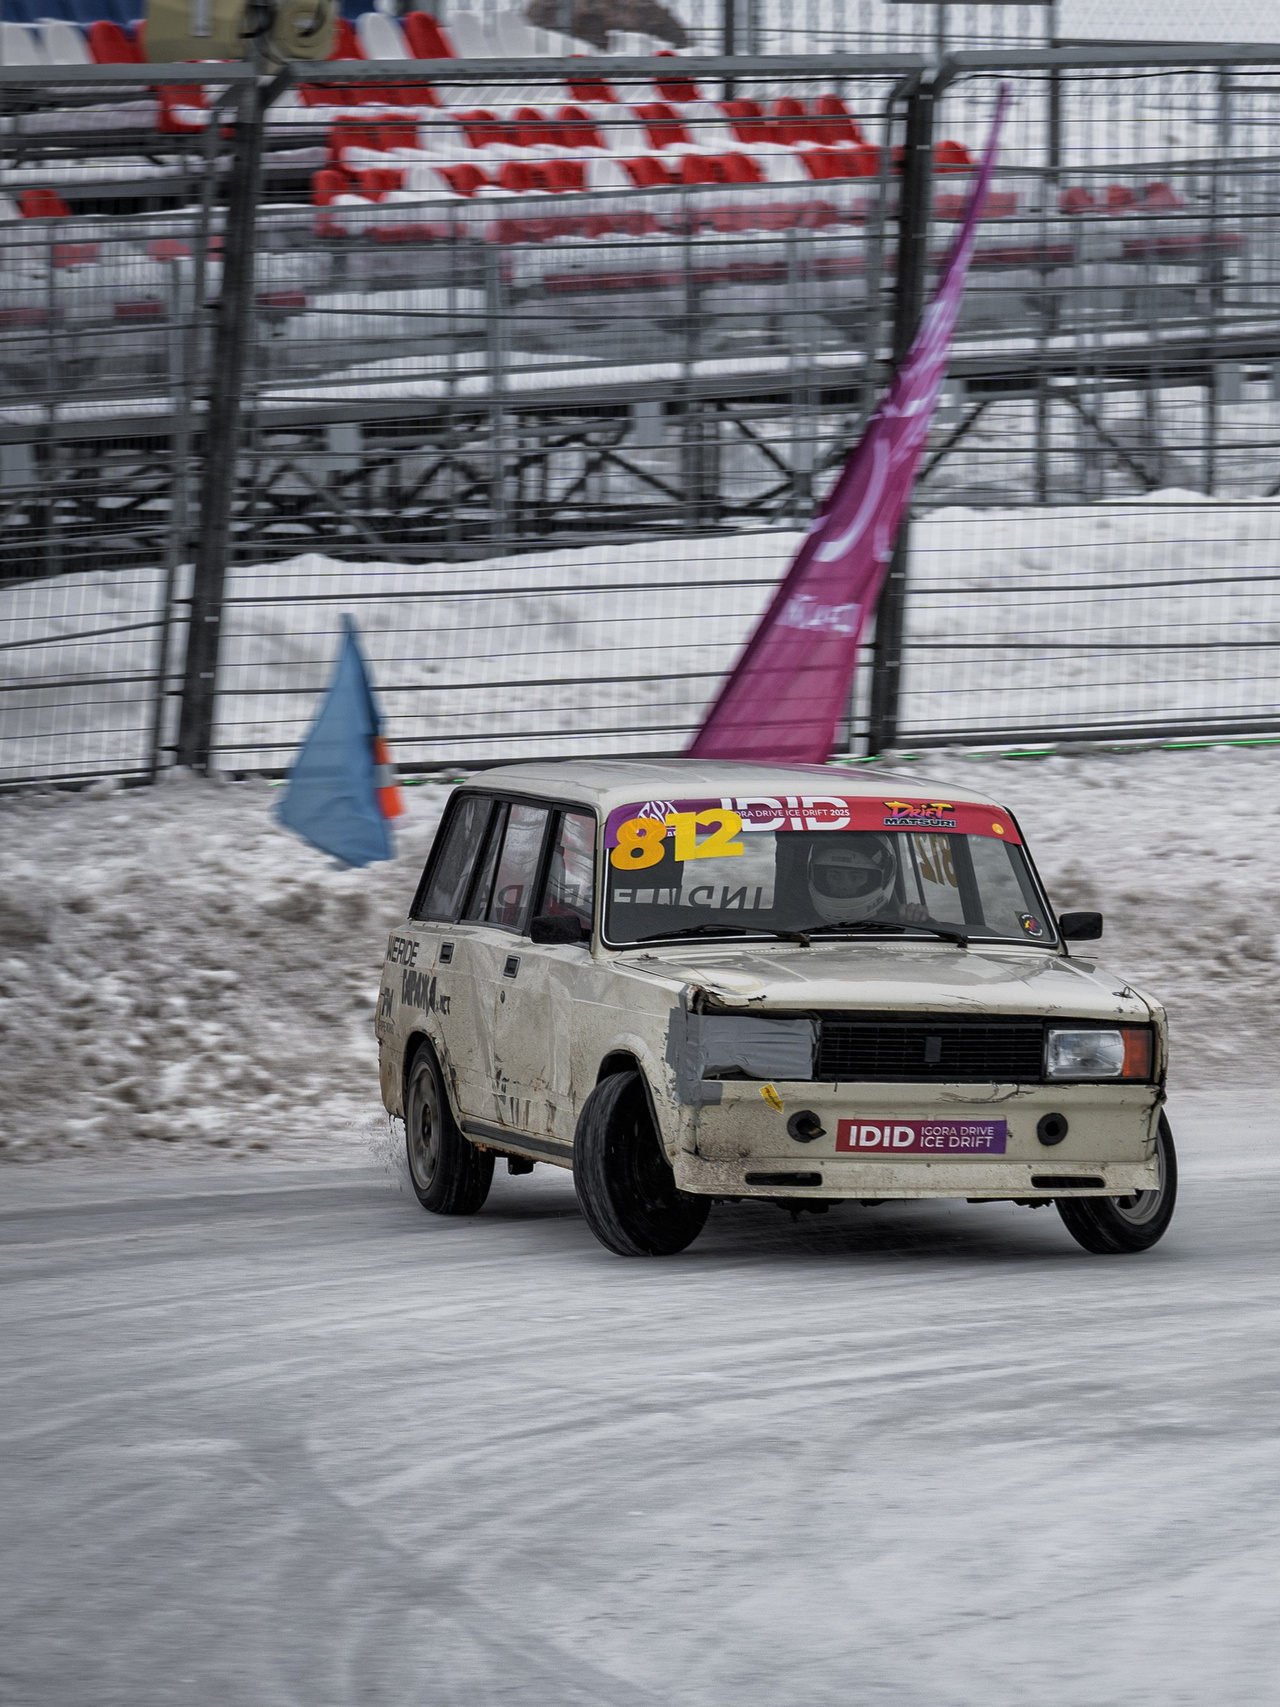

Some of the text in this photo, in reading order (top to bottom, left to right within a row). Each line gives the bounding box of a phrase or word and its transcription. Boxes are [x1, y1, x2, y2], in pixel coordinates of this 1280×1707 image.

[734, 810, 754, 818] ORA
[802, 809, 828, 817] DRIFT
[883, 818, 956, 828] MATSURI
[610, 808, 745, 870] 812
[849, 1126, 915, 1147] IDID
[921, 1127, 994, 1136] IGORA DRIVE
[920, 1136, 994, 1148] ICE DRIFT
